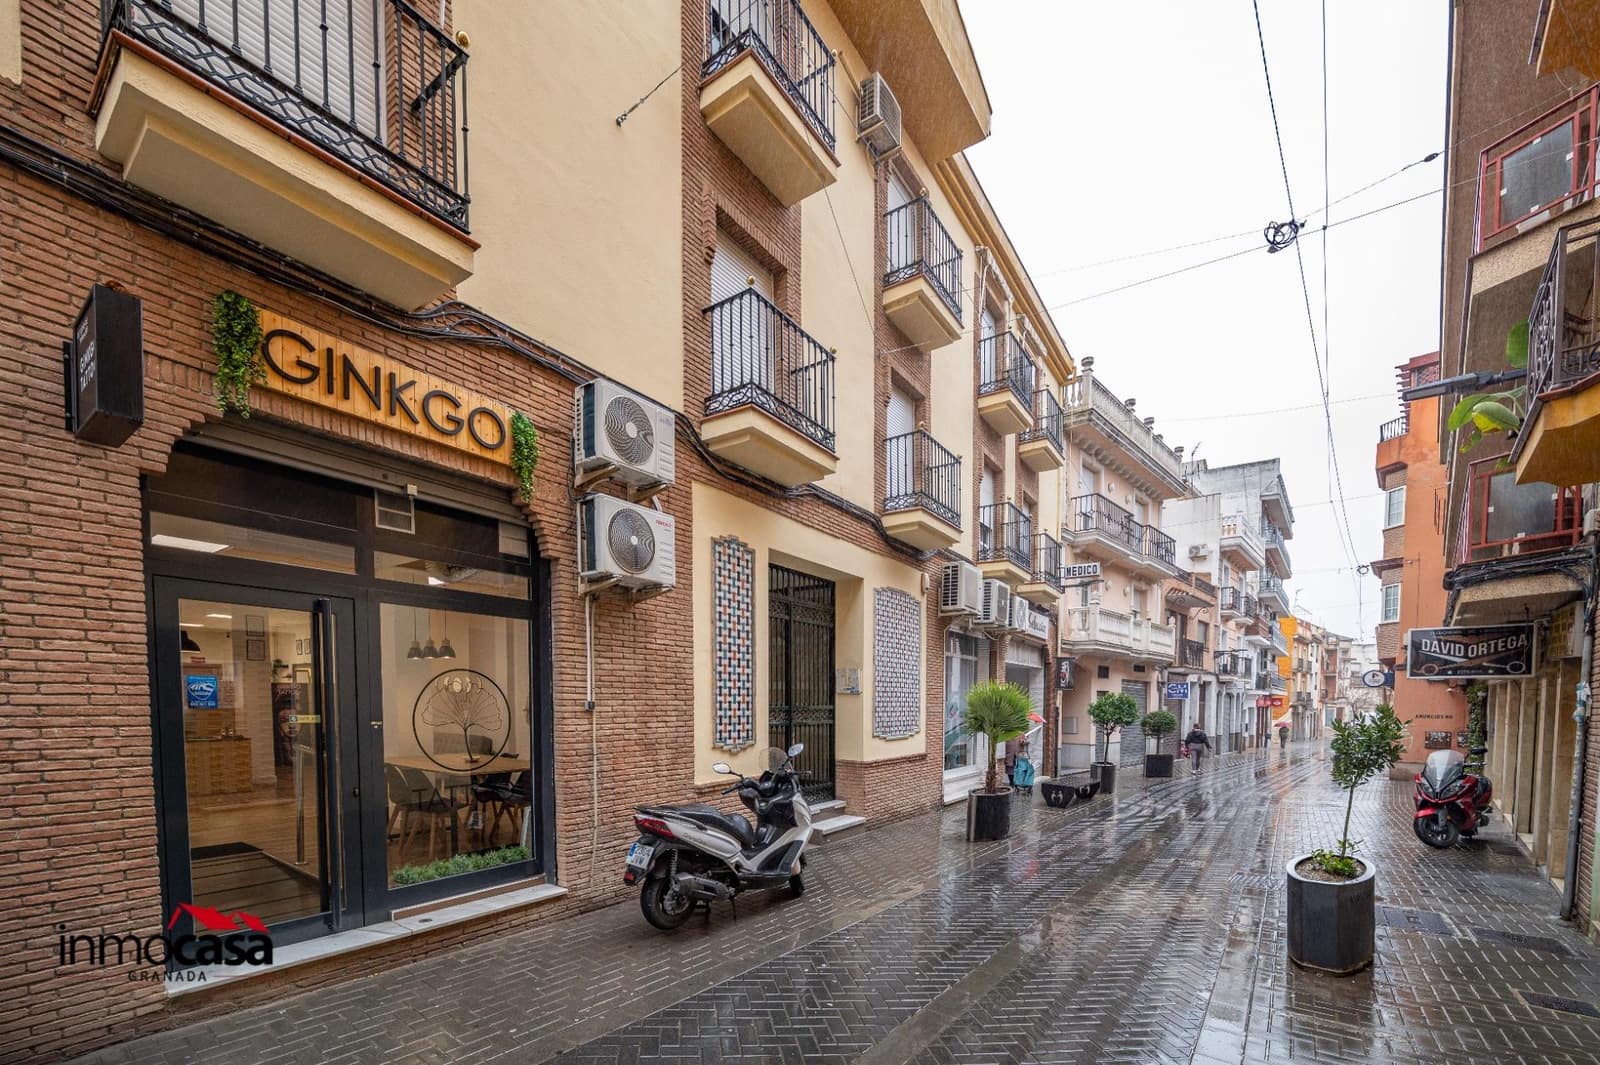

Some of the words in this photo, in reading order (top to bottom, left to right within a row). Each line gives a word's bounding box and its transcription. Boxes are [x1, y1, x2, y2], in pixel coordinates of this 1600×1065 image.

[261, 328, 506, 450] GINKGO
[1421, 638, 1465, 657] DAVID
[1467, 634, 1528, 658] ORTEGA
